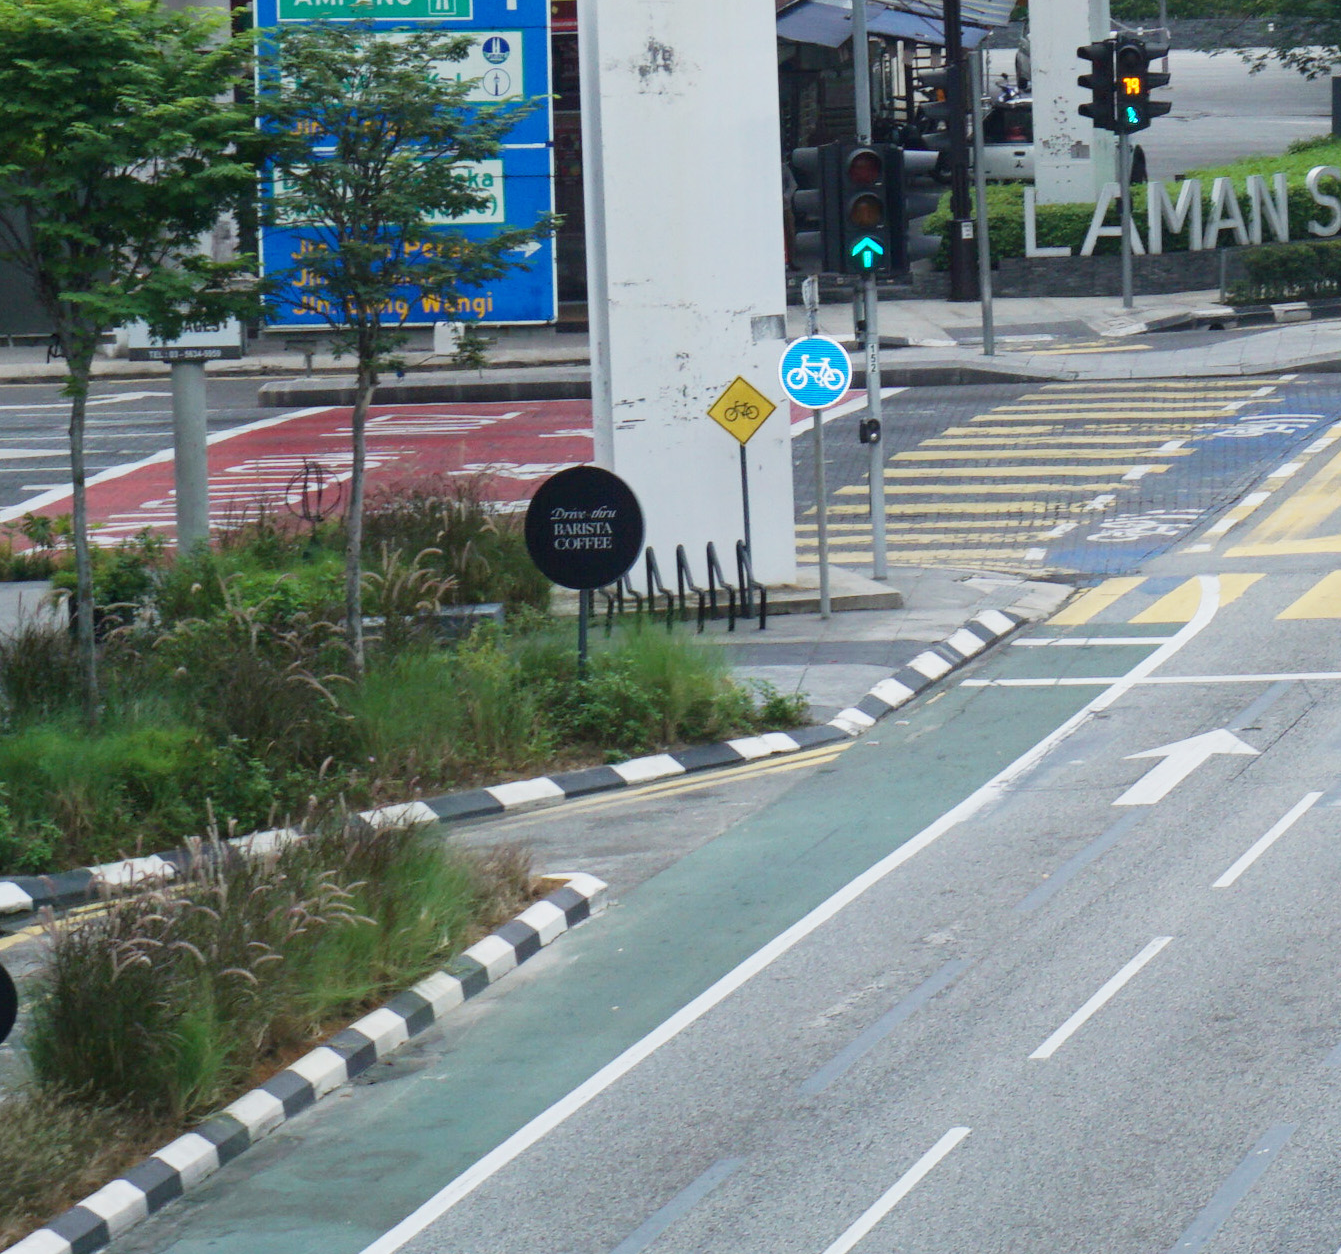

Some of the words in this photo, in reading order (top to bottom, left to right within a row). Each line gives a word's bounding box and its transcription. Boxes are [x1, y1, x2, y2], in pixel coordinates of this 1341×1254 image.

[1024, 172, 1290, 258] LAMAN
[554, 522, 613, 535] BARISTA
[554, 537, 612, 550] COFFEE
